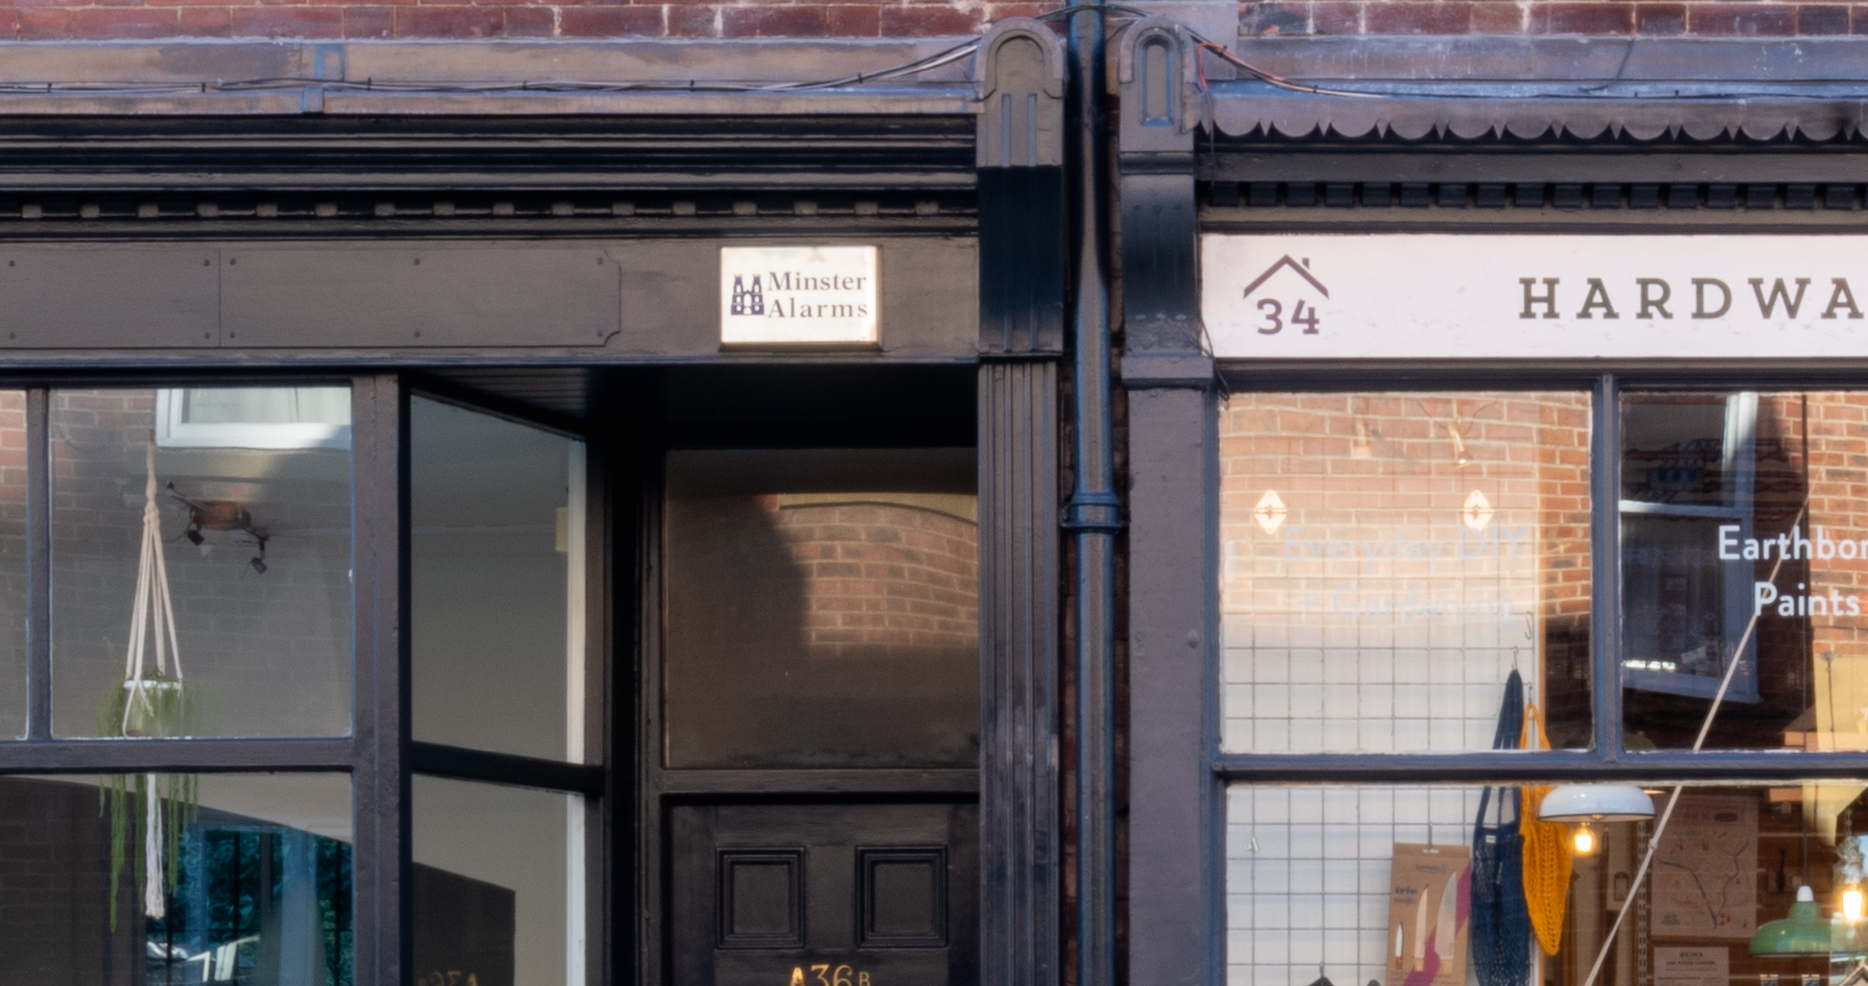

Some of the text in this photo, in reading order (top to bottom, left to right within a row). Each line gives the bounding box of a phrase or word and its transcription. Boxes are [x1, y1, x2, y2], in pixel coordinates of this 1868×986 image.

[767, 271, 868, 292] Minster
[767, 298, 869, 319] Alarms
[1257, 298, 1321, 336] 34
[1754, 583, 1860, 618] Paints
